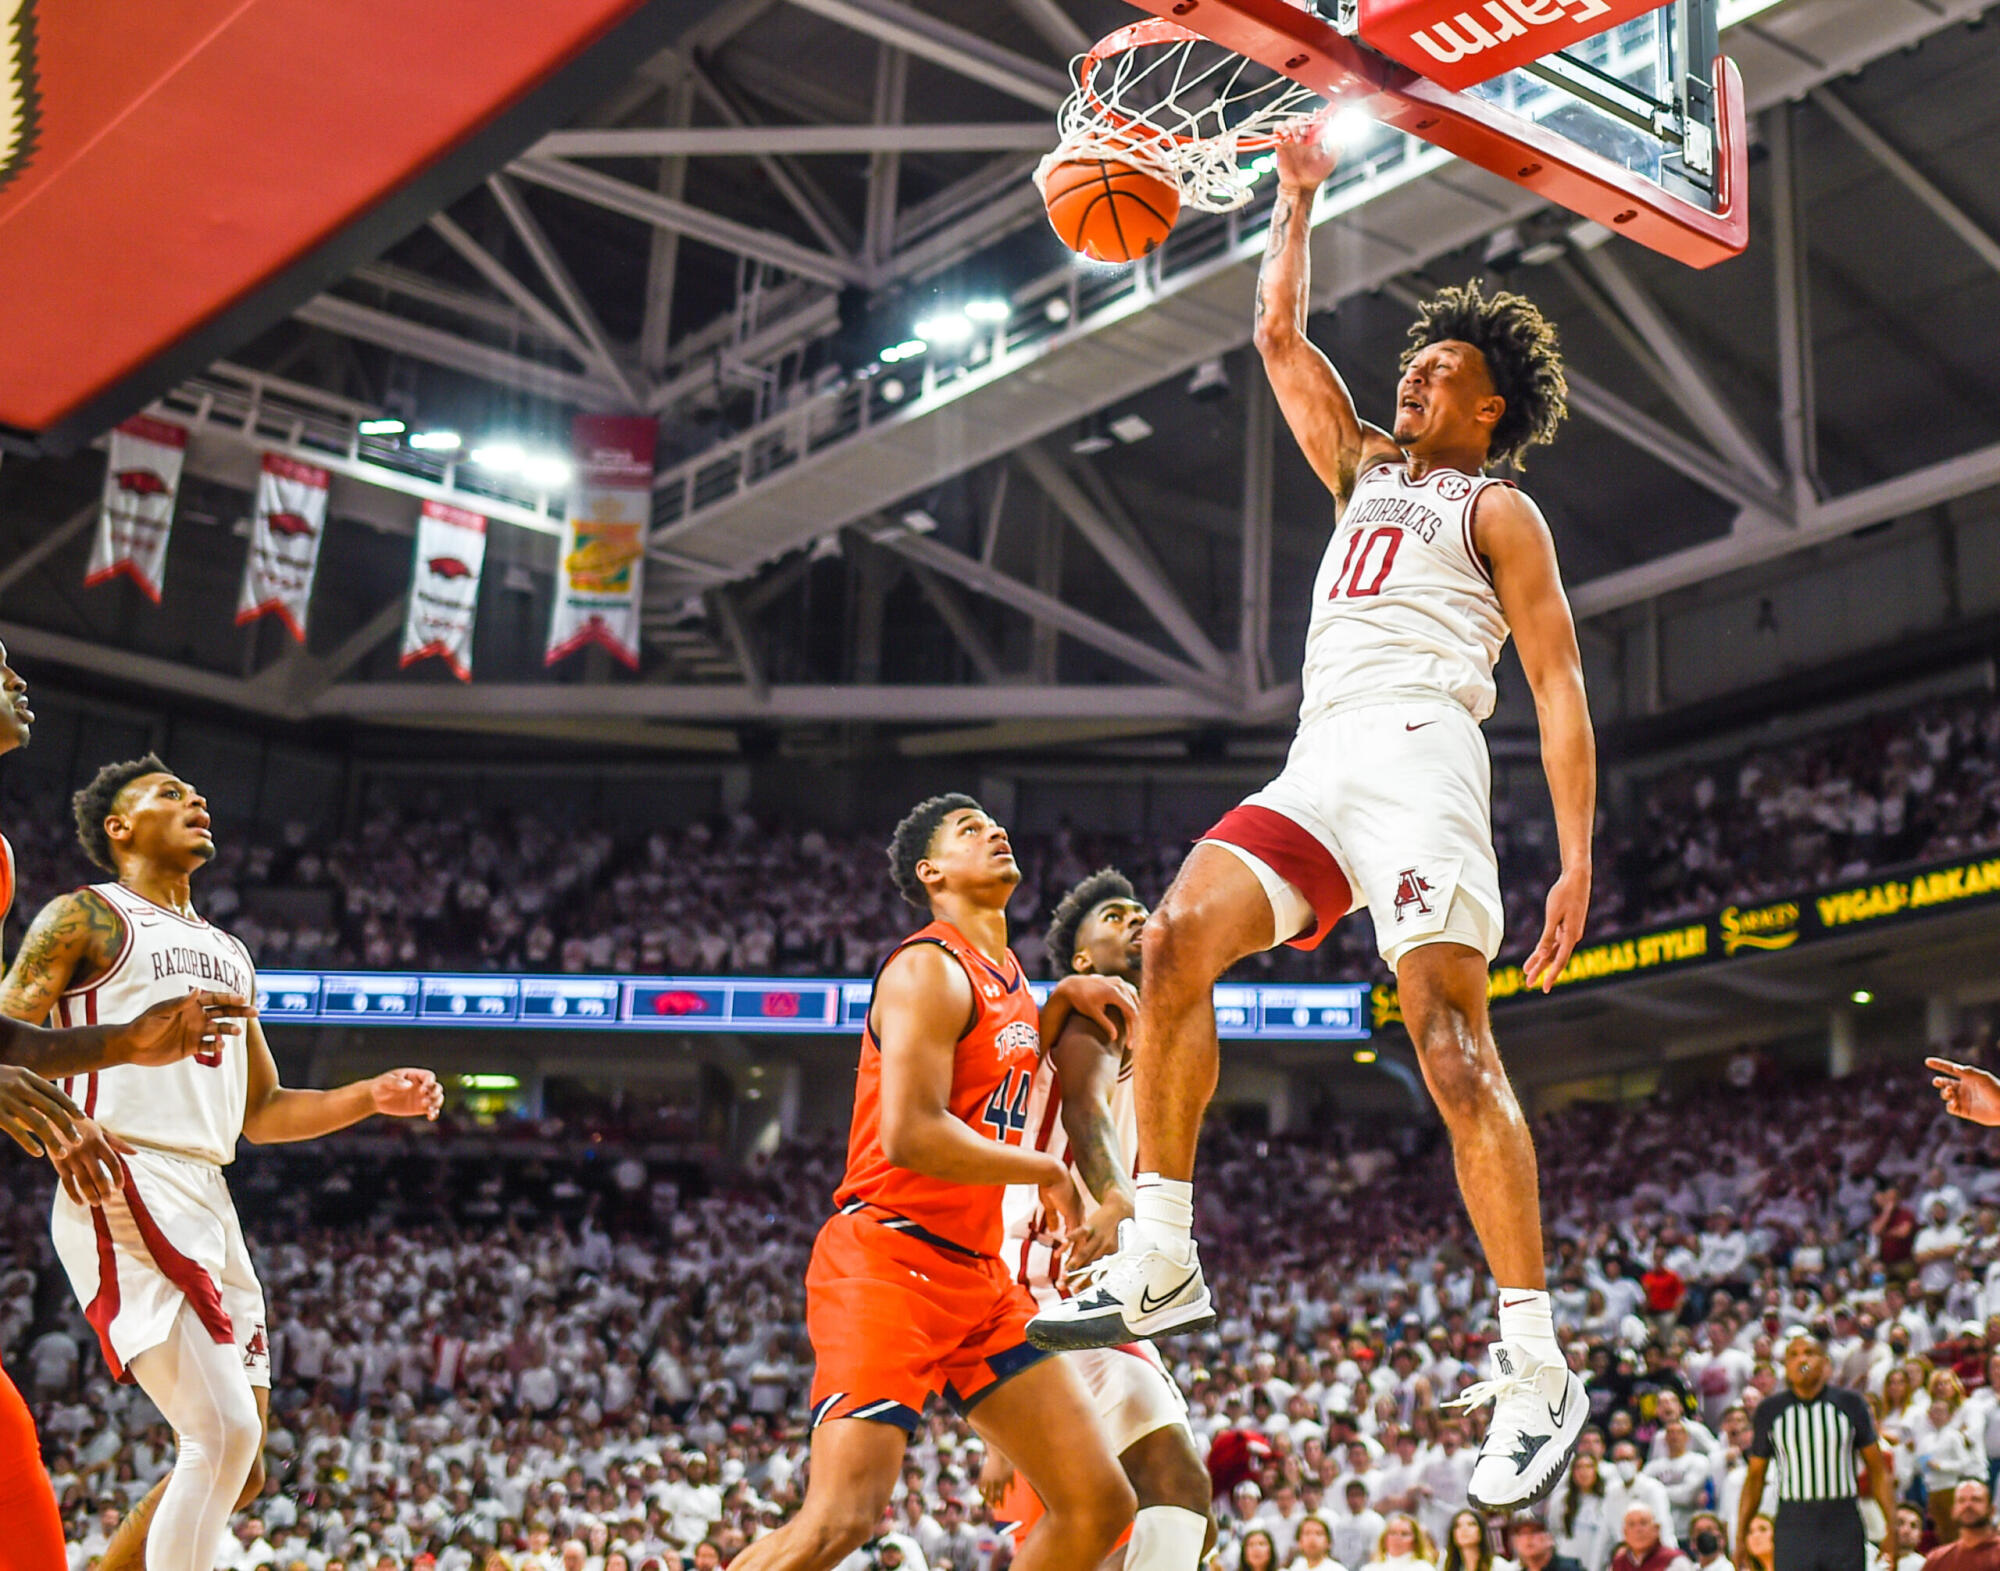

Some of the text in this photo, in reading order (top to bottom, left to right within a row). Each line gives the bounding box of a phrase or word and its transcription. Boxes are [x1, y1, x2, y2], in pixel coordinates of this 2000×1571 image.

[1409, 0, 1612, 63] Farm
[1345, 498, 1442, 544] AZORBACKS
[1328, 527, 1404, 600] 10
[151, 947, 248, 997] RAZORBACKS
[1527, 941, 1637, 991] ANSAS
[982, 1066, 1032, 1143] 44
